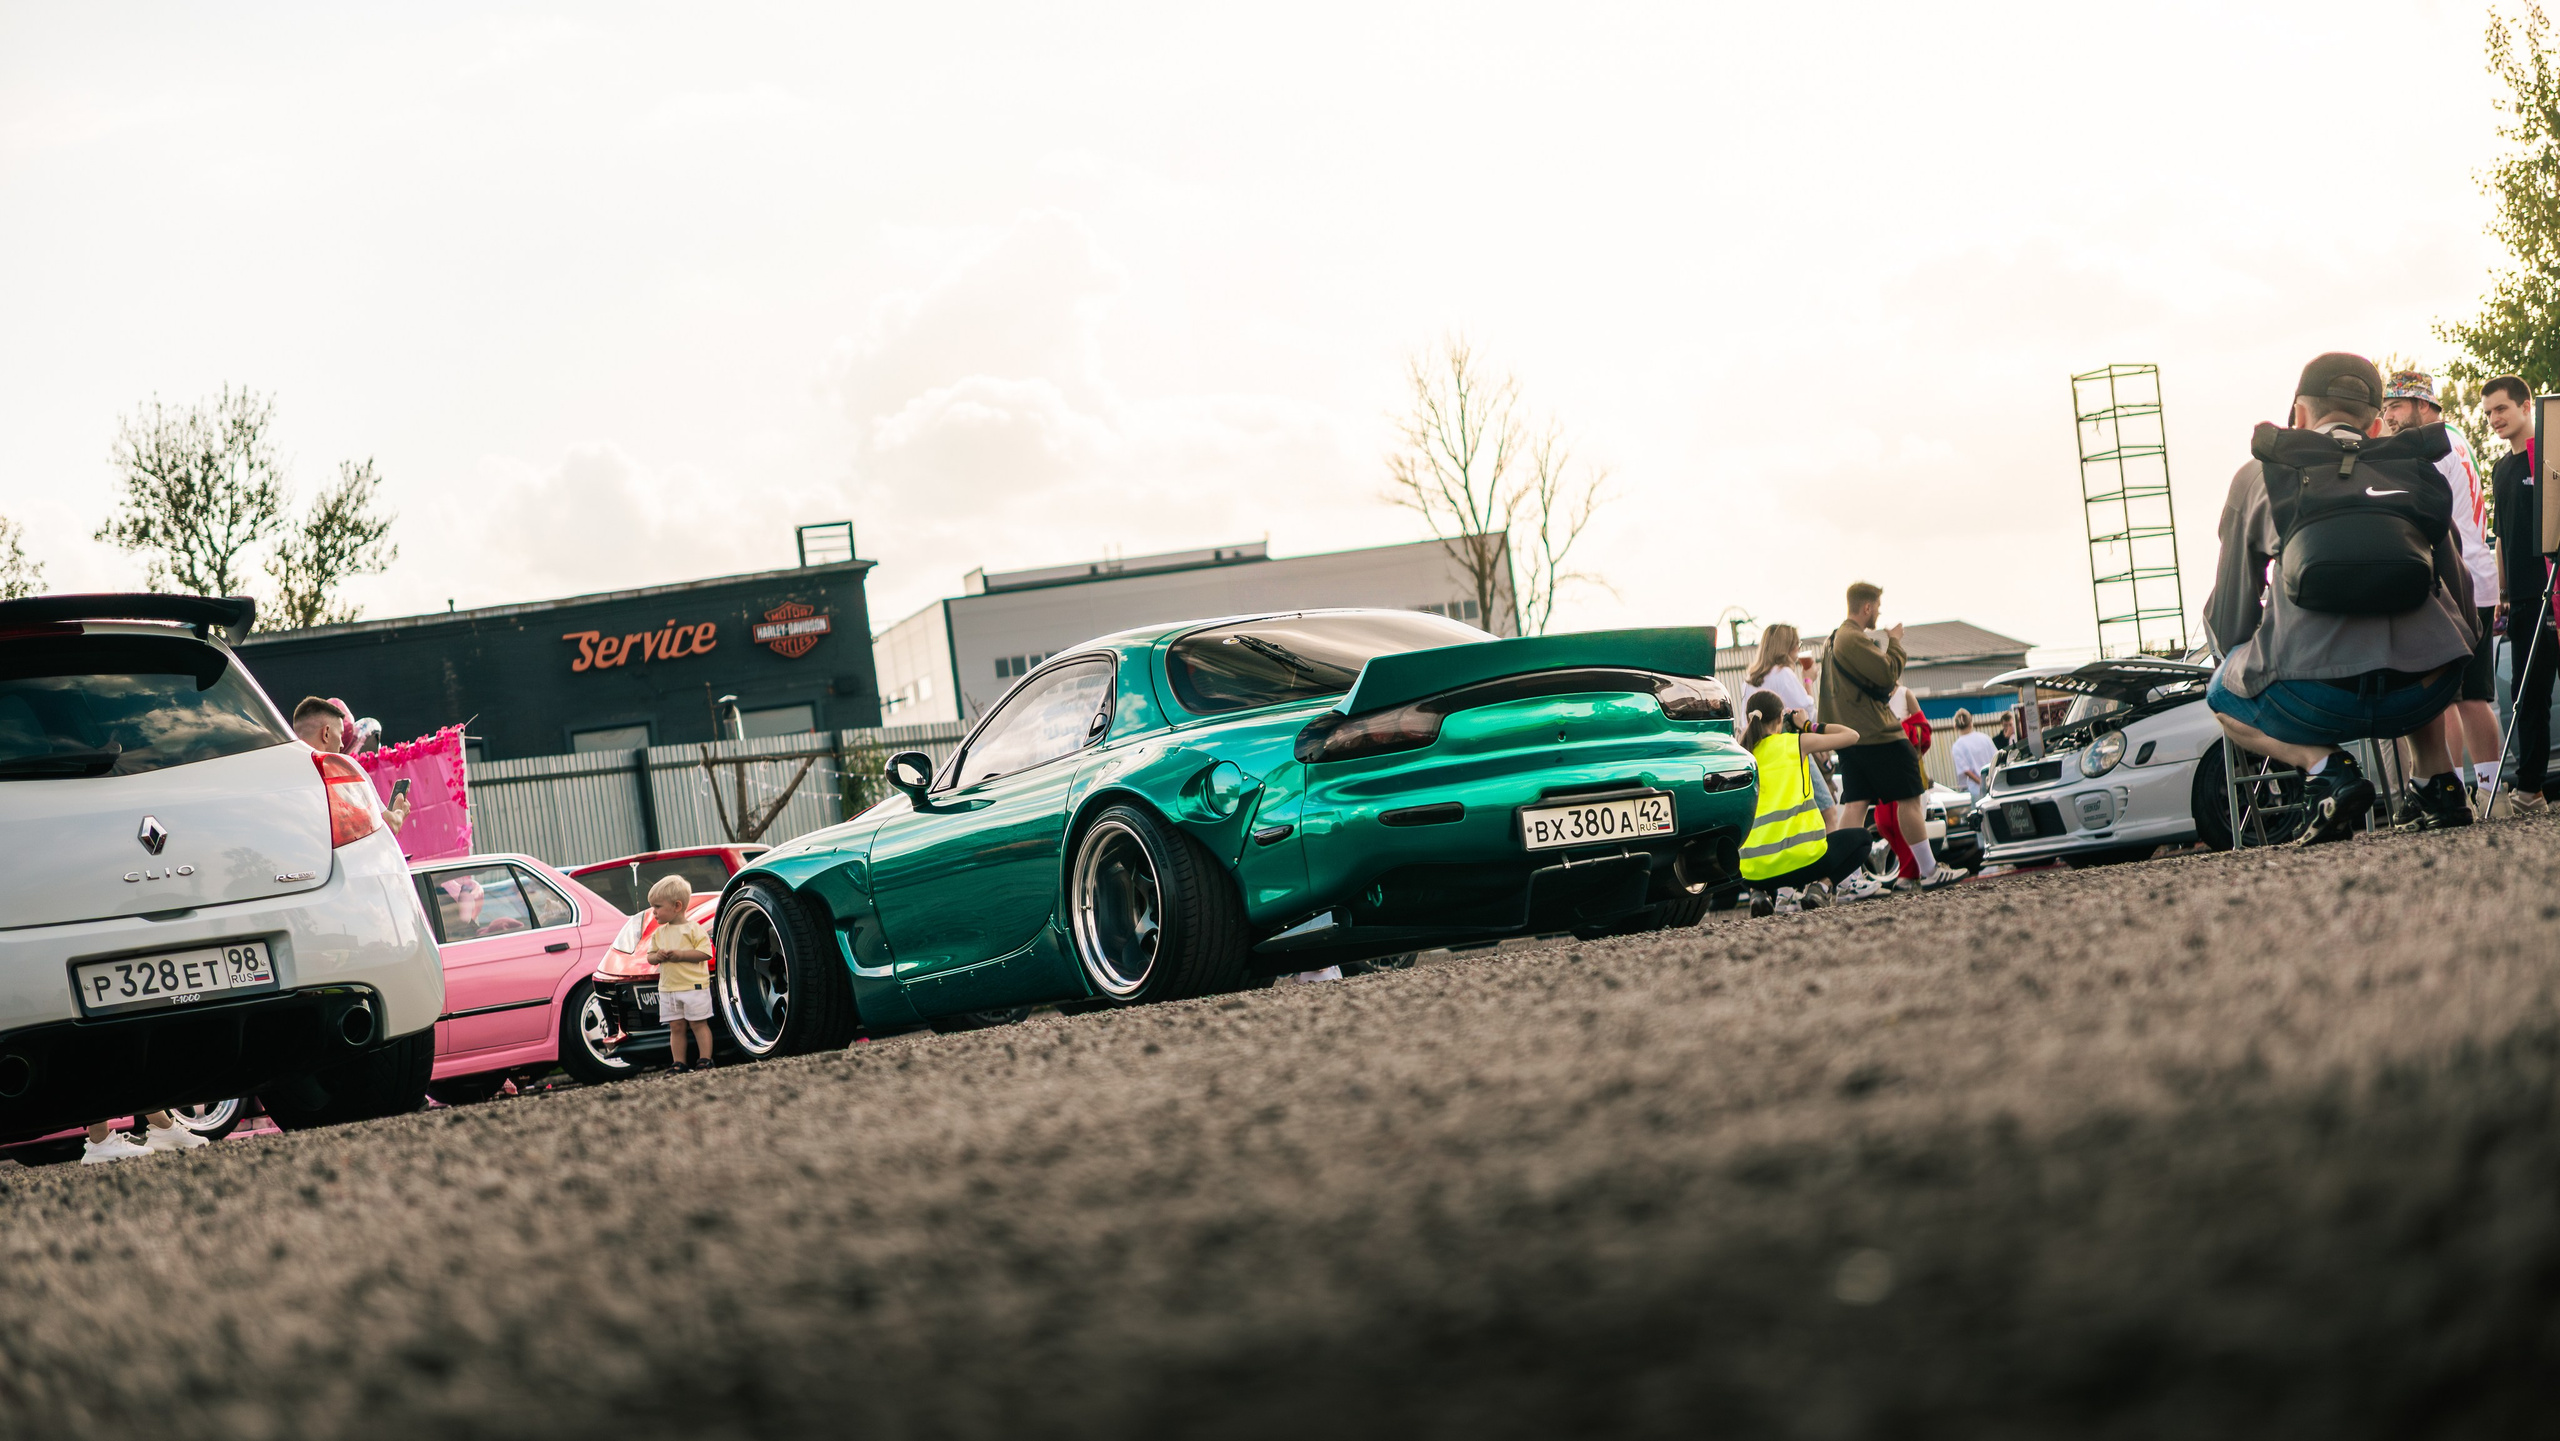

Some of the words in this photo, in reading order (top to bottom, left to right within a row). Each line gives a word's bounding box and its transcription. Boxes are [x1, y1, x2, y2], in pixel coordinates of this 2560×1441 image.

[771, 605, 809, 621] MOTOR
[756, 618, 827, 640] HARLEY-DAVIDSON
[562, 619, 717, 672] Service
[775, 636, 812, 653] CYCLES
[1639, 800, 1663, 823] 42
[1640, 822, 1657, 832] RUS
[123, 864, 195, 883] CLIO
[228, 947, 259, 974] 98
[231, 972, 254, 984] RUS
[170, 993, 200, 1005] T-1000
